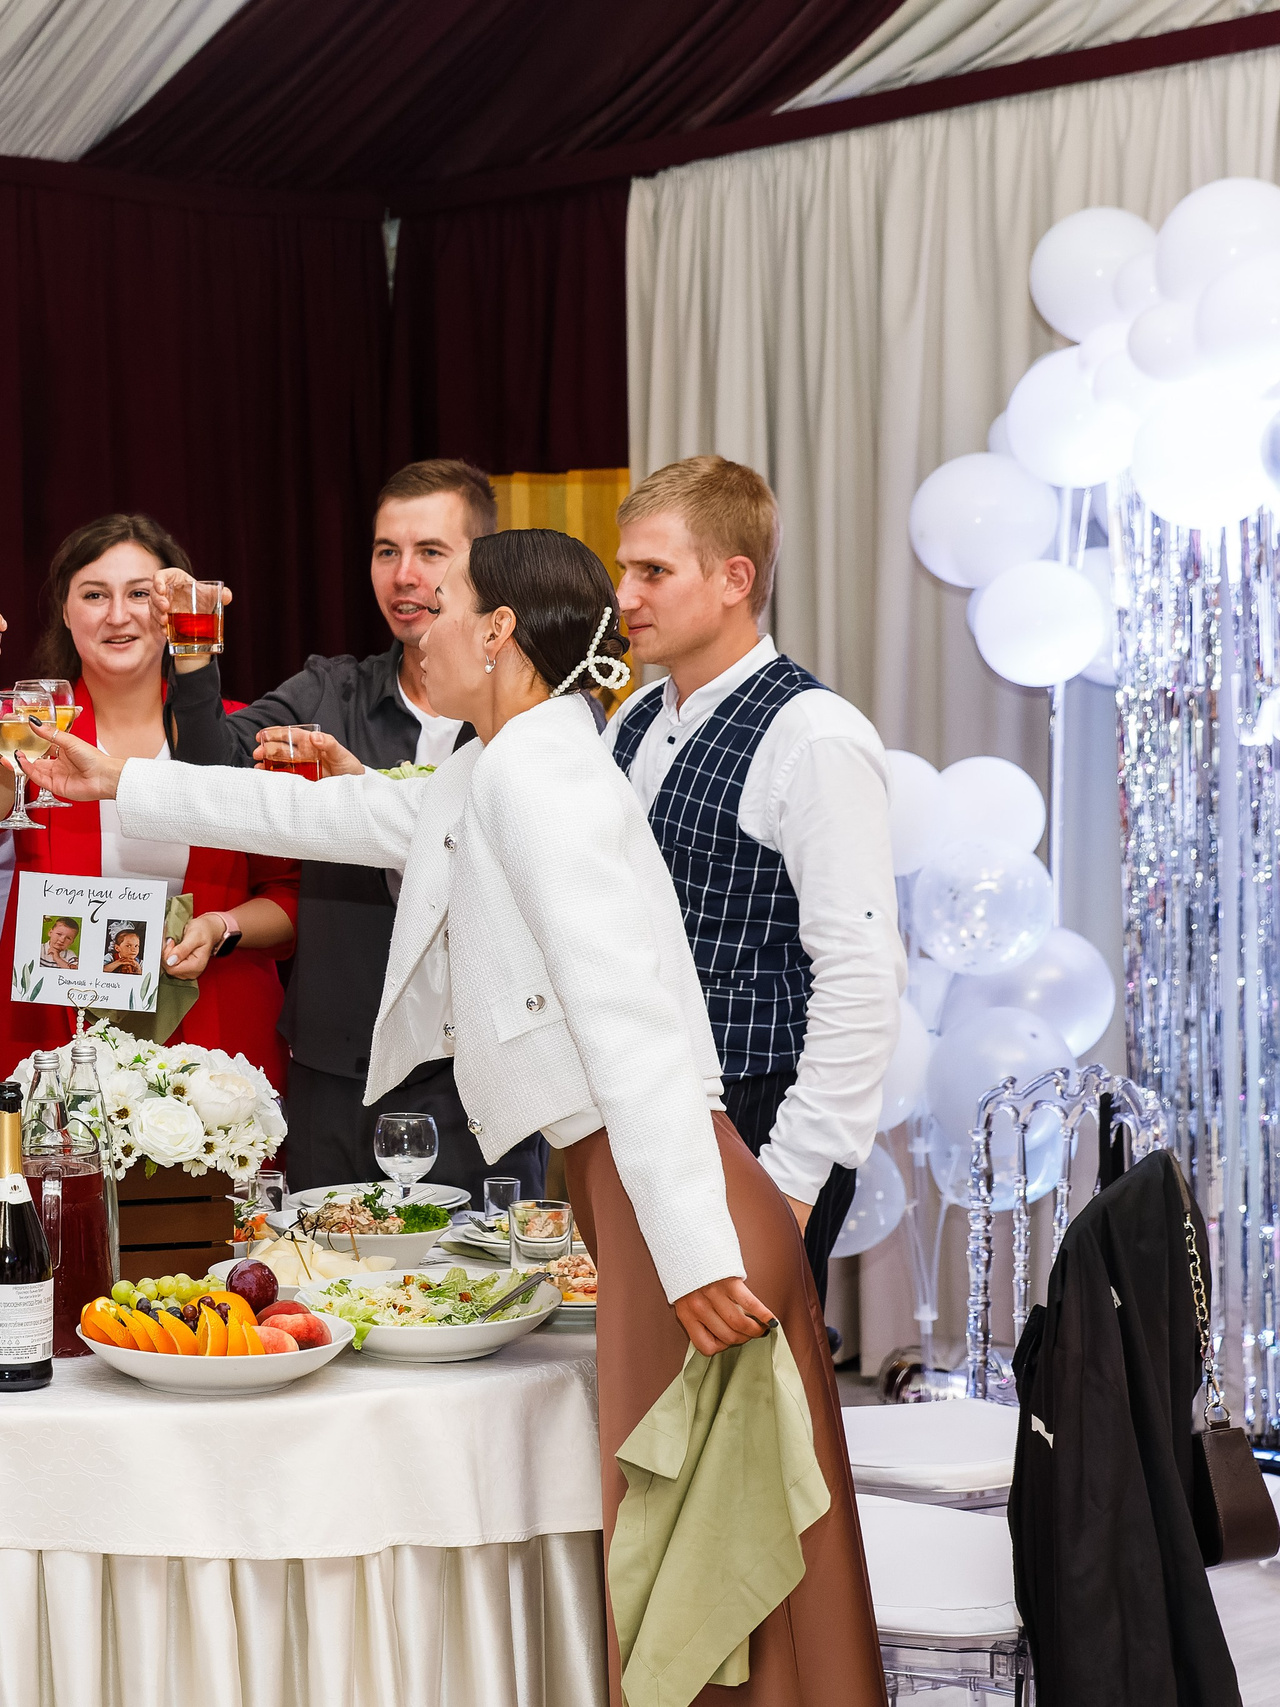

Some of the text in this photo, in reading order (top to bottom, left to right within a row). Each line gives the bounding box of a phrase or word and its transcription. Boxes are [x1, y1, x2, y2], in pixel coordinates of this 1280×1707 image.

[43, 880, 153, 905] Когда нам было
[87, 898, 107, 923] 7
